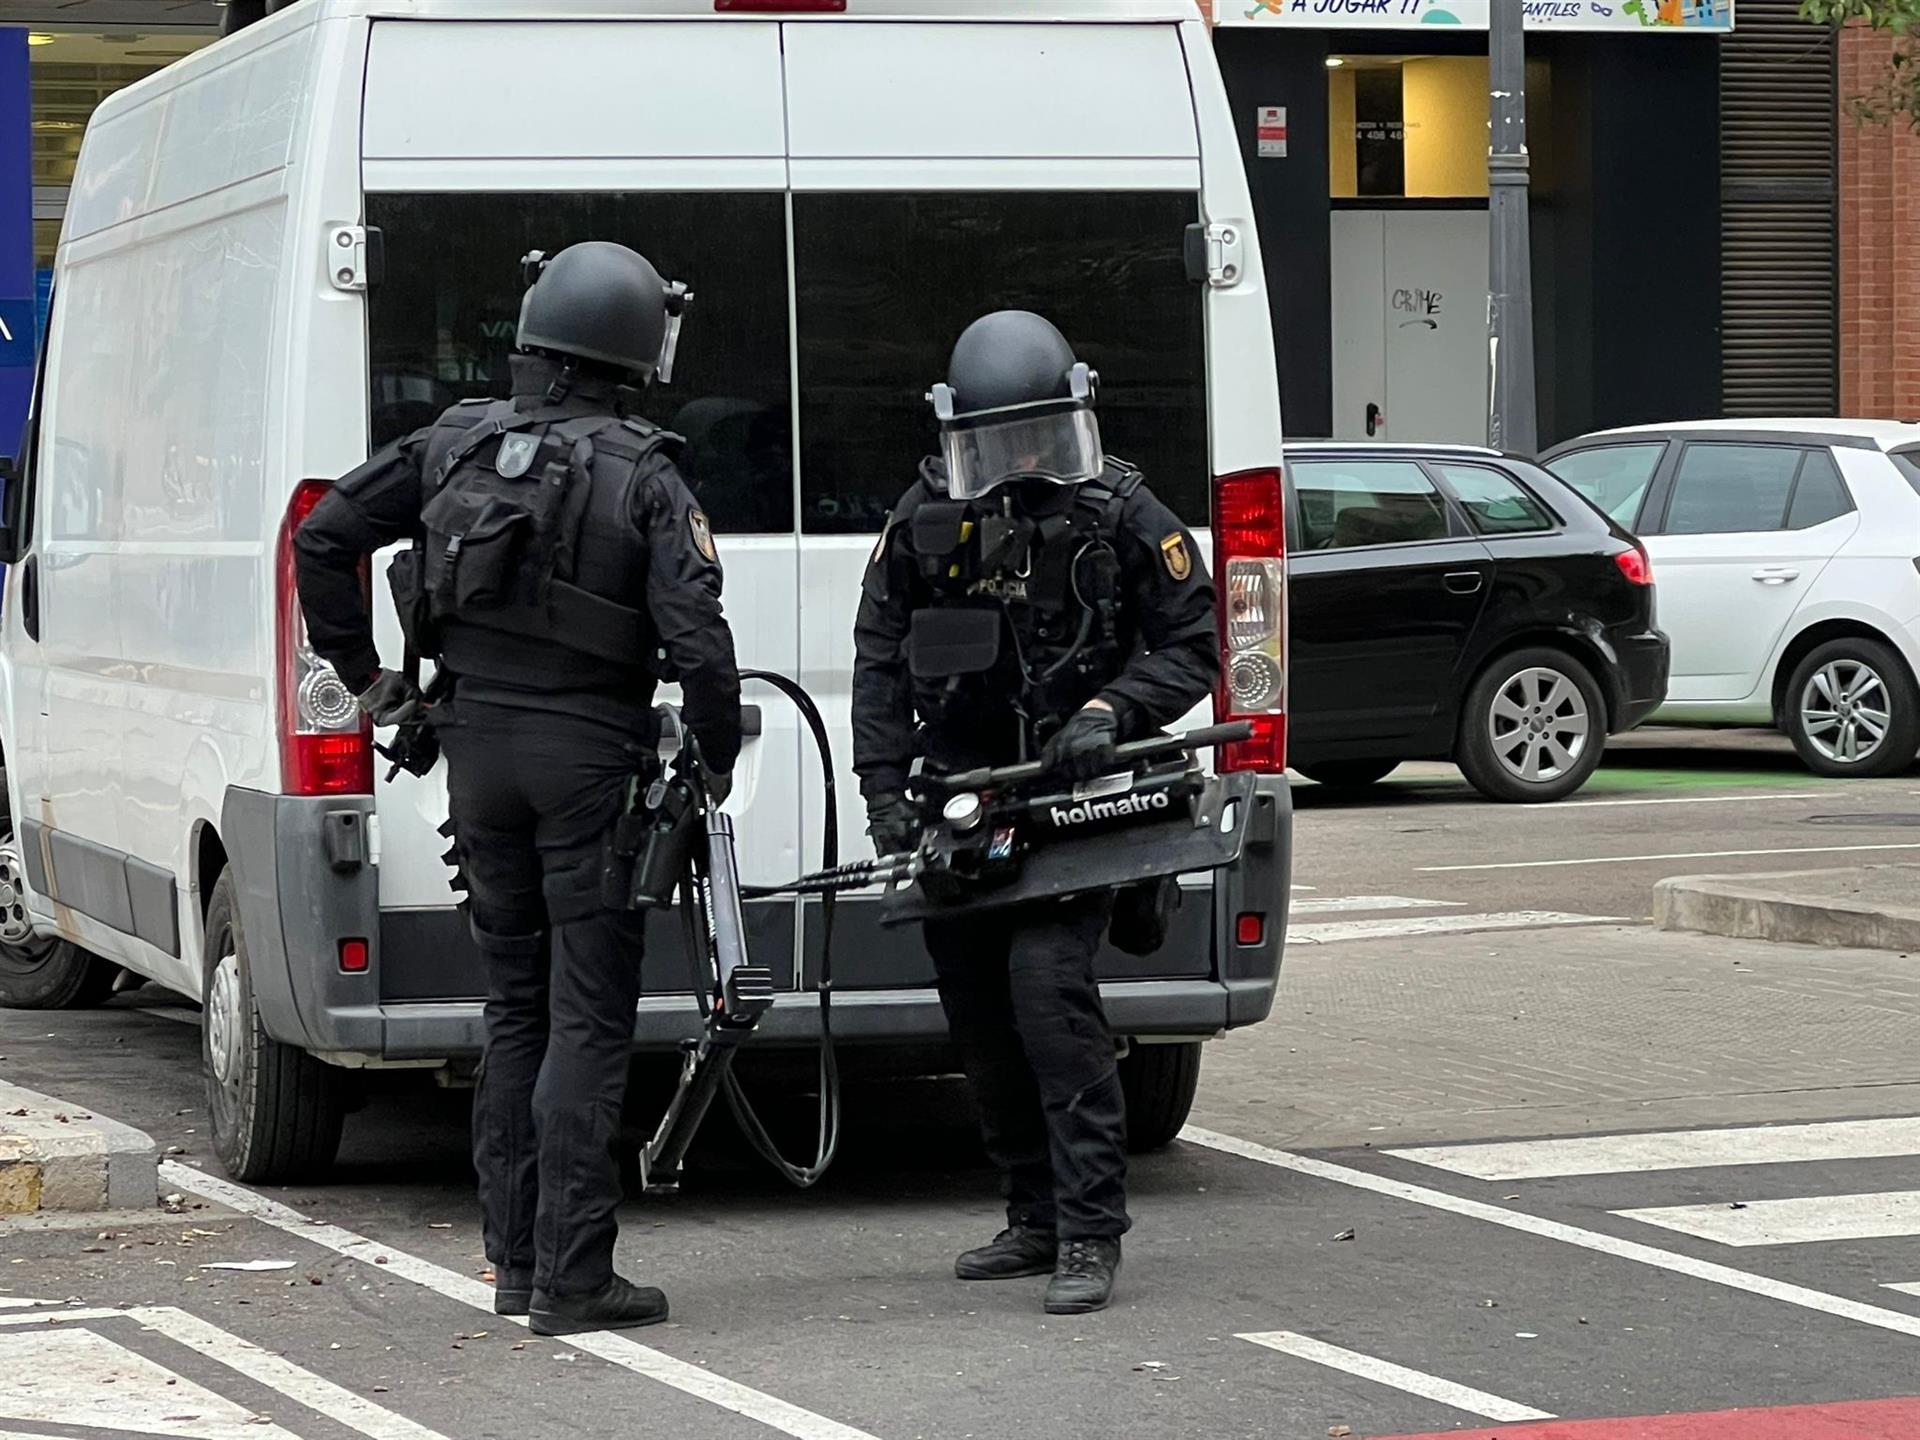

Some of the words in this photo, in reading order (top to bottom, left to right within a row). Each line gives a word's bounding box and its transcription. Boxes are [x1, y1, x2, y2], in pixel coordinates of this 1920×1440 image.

[1314, 0, 1391, 14] JUGAR
[1522, 2, 1581, 17] ANTILES
[1050, 791, 1169, 827] holmatro
